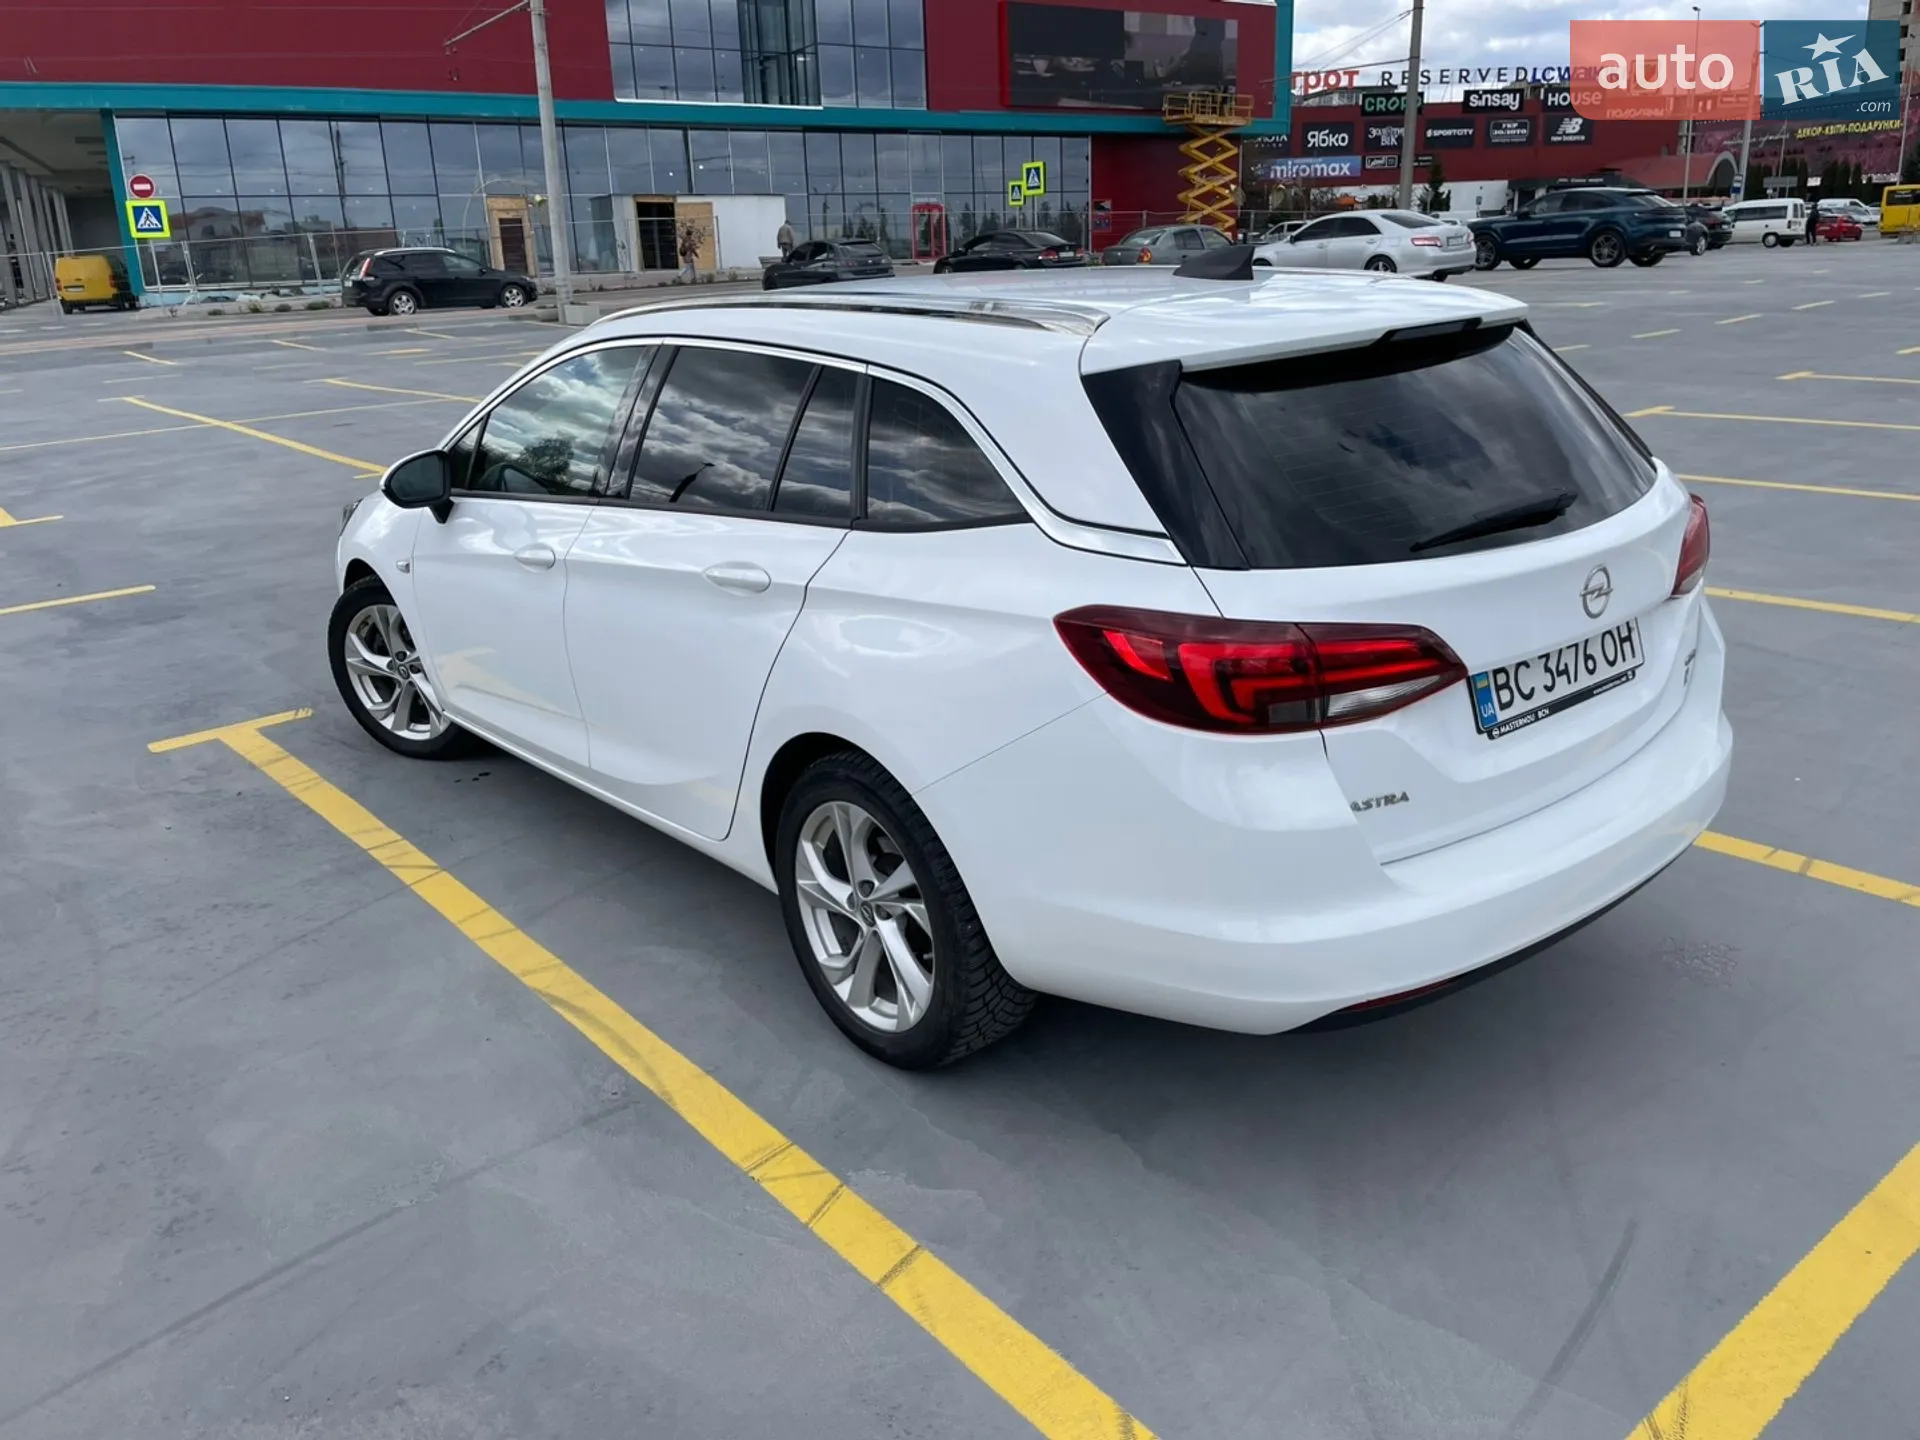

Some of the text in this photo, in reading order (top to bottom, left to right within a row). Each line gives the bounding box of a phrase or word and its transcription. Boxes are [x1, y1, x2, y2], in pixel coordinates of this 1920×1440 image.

[1381, 67, 1528, 87] RESERVED
[1469, 90, 1520, 110] sinsay
[1307, 129, 1349, 148] Ябко
[1270, 160, 1351, 178] miromax
[1492, 621, 1636, 711] BC 3476 OH
[1481, 702, 1495, 718] UA
[1350, 791, 1410, 812] ASTRA
